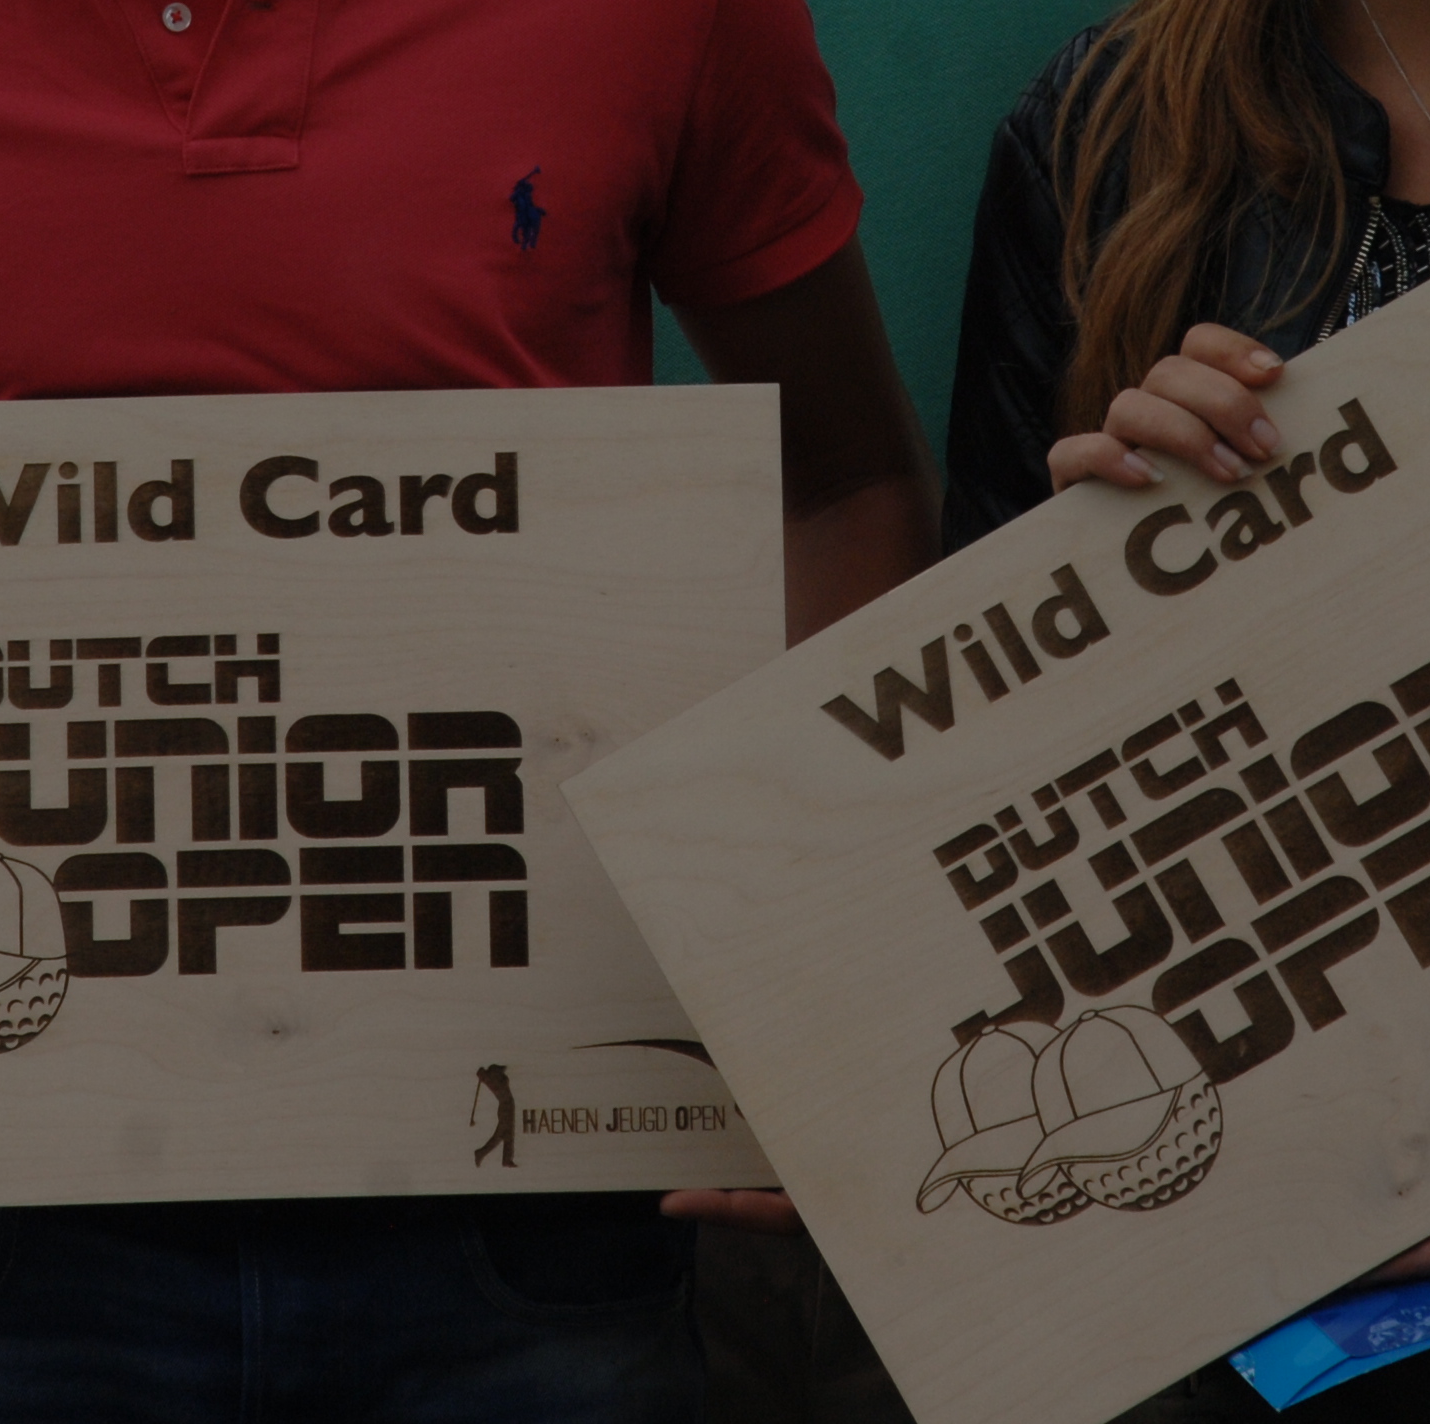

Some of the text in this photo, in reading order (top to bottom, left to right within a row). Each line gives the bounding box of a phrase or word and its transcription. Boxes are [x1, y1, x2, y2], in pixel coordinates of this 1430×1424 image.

[239, 450, 520, 539] Card
[820, 398, 1398, 762] Wild Card
[932, 677, 1267, 912] DUTCH
[54, 843, 529, 978] OPEN
[522, 1105, 726, 1134] HAENEN JEUGD OPEN
